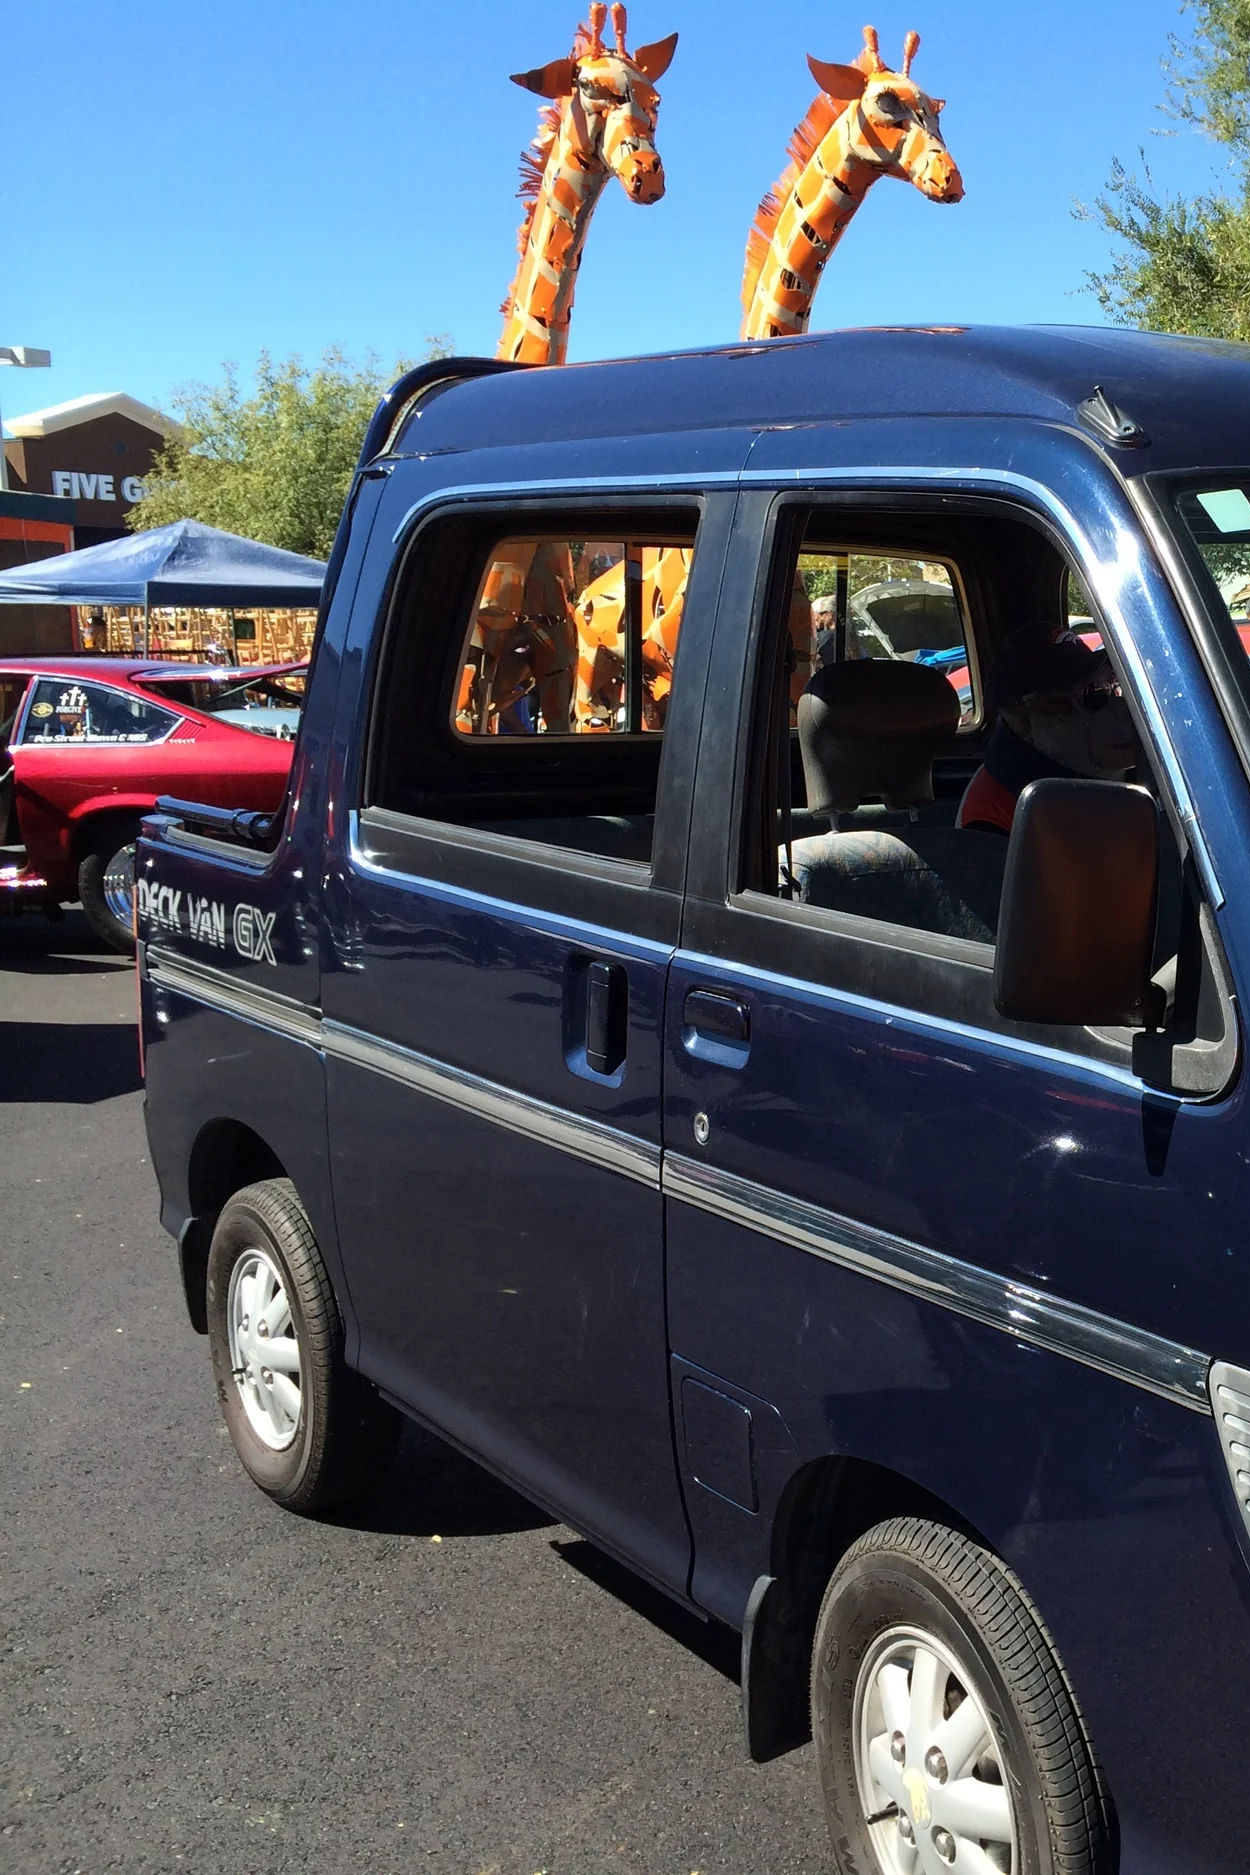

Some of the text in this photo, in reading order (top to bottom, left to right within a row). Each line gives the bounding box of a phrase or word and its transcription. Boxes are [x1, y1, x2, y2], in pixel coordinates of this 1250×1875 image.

[51, 471, 116, 501] FIVE
[137, 879, 278, 967] DECK VAN GX
